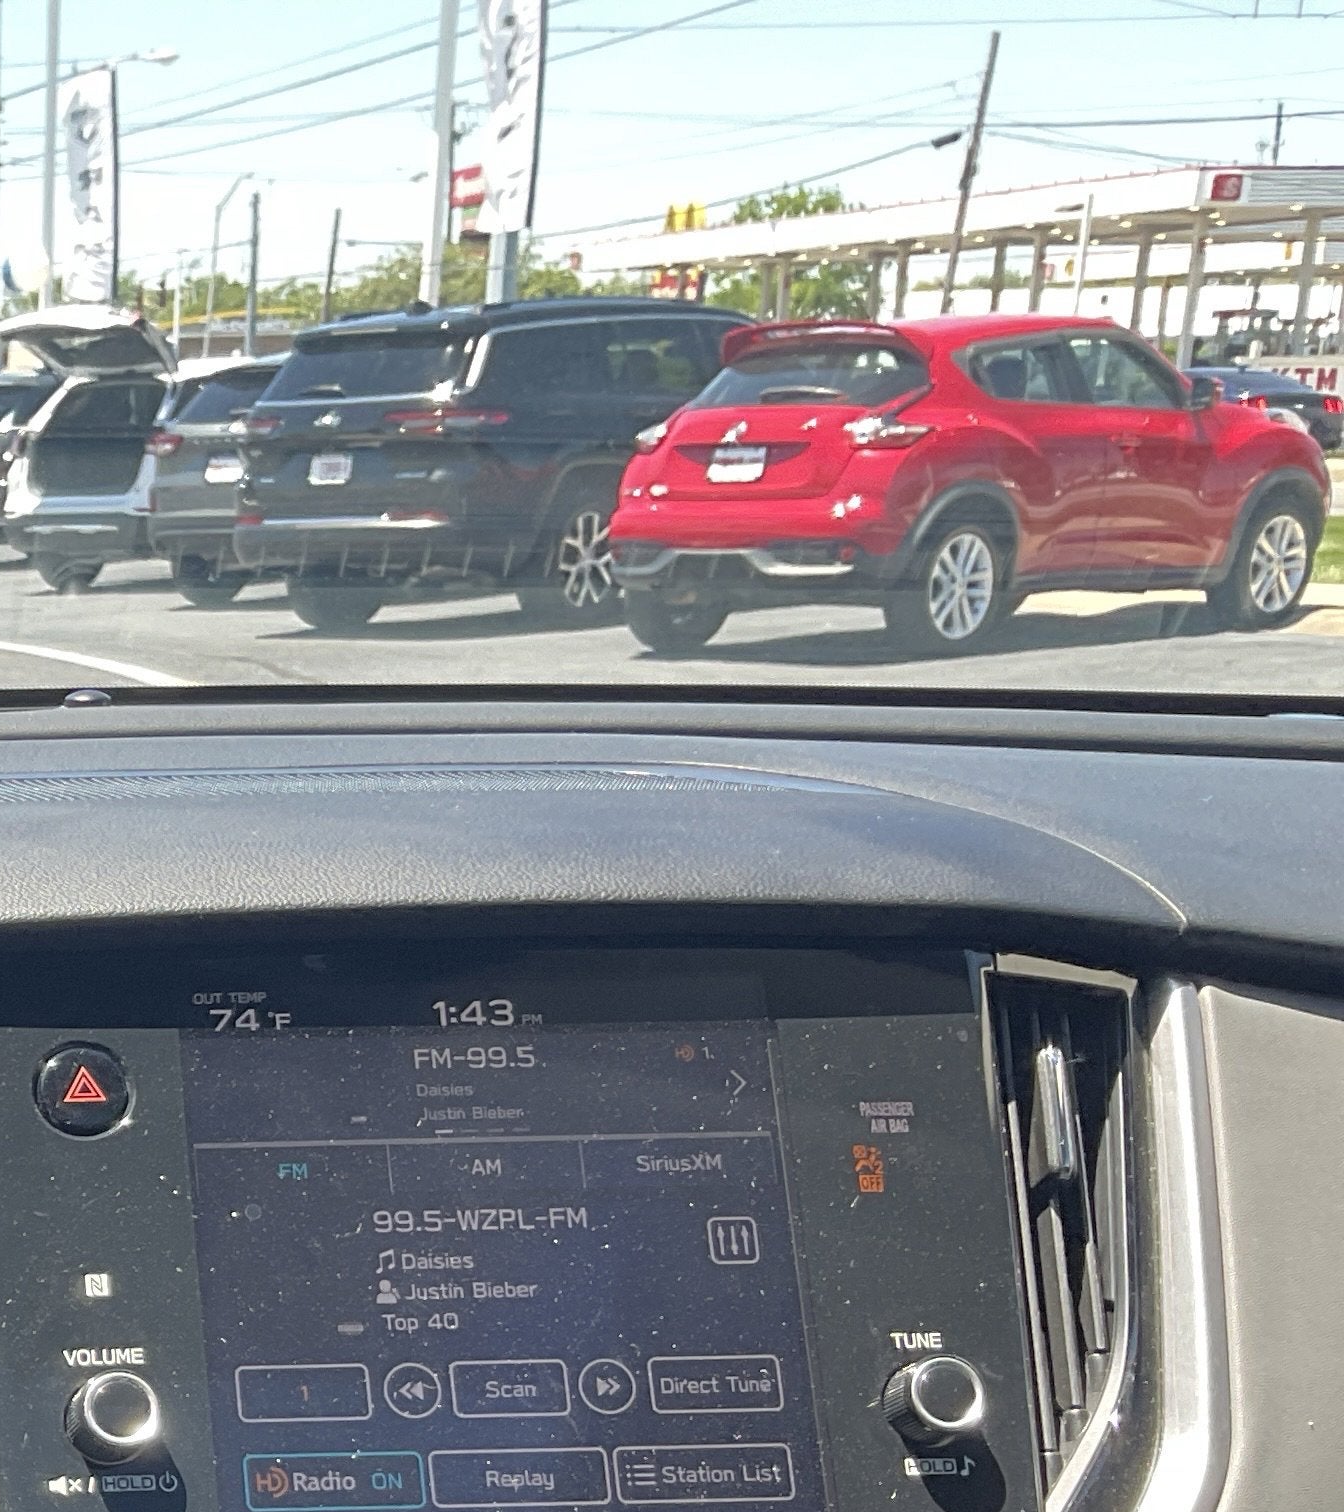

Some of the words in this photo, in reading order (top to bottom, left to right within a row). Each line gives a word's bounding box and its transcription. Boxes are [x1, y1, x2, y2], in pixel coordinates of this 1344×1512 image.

[192, 992, 223, 1006] OUT
[227, 991, 267, 1005] TEMP
[209, 1008, 261, 1033] 74
[431, 999, 515, 1028] 1:43
[522, 1014, 543, 1025] PM
[413, 1046, 536, 1070] FM-99.5
[416, 1083, 474, 1098] Daisies
[419, 1107, 467, 1121] Justin
[471, 1105, 523, 1120] Bieber
[859, 1101, 915, 1117] PASSENGER
[870, 1118, 888, 1134] AIR
[888, 1117, 910, 1134] BAG
[278, 1162, 308, 1180] FM
[471, 1158, 502, 1177] AM
[635, 1153, 723, 1173] SiriusXM
[861, 1176, 882, 1191] OFF
[372, 1206, 589, 1233] 99.5-WZPL-FM
[401, 1253, 475, 1270] Daisies
[405, 1282, 465, 1300] Justin
[472, 1281, 539, 1299] Bieber
[380, 1313, 419, 1334] Top
[427, 1312, 460, 1330] 40
[890, 1332, 943, 1350] TUNE
[62, 1348, 145, 1367] VOLUME
[485, 1380, 537, 1399] Scan
[660, 1376, 720, 1395] Direct
[725, 1375, 772, 1394] Tune
[662, 1466, 735, 1484] Station
[742, 1464, 782, 1483] List
[905, 1458, 957, 1476] HOLD
[103, 1476, 155, 1492] HOLD
[292, 1471, 356, 1492] Radio
[370, 1471, 403, 1491] ON
[485, 1469, 555, 1491] Replay
